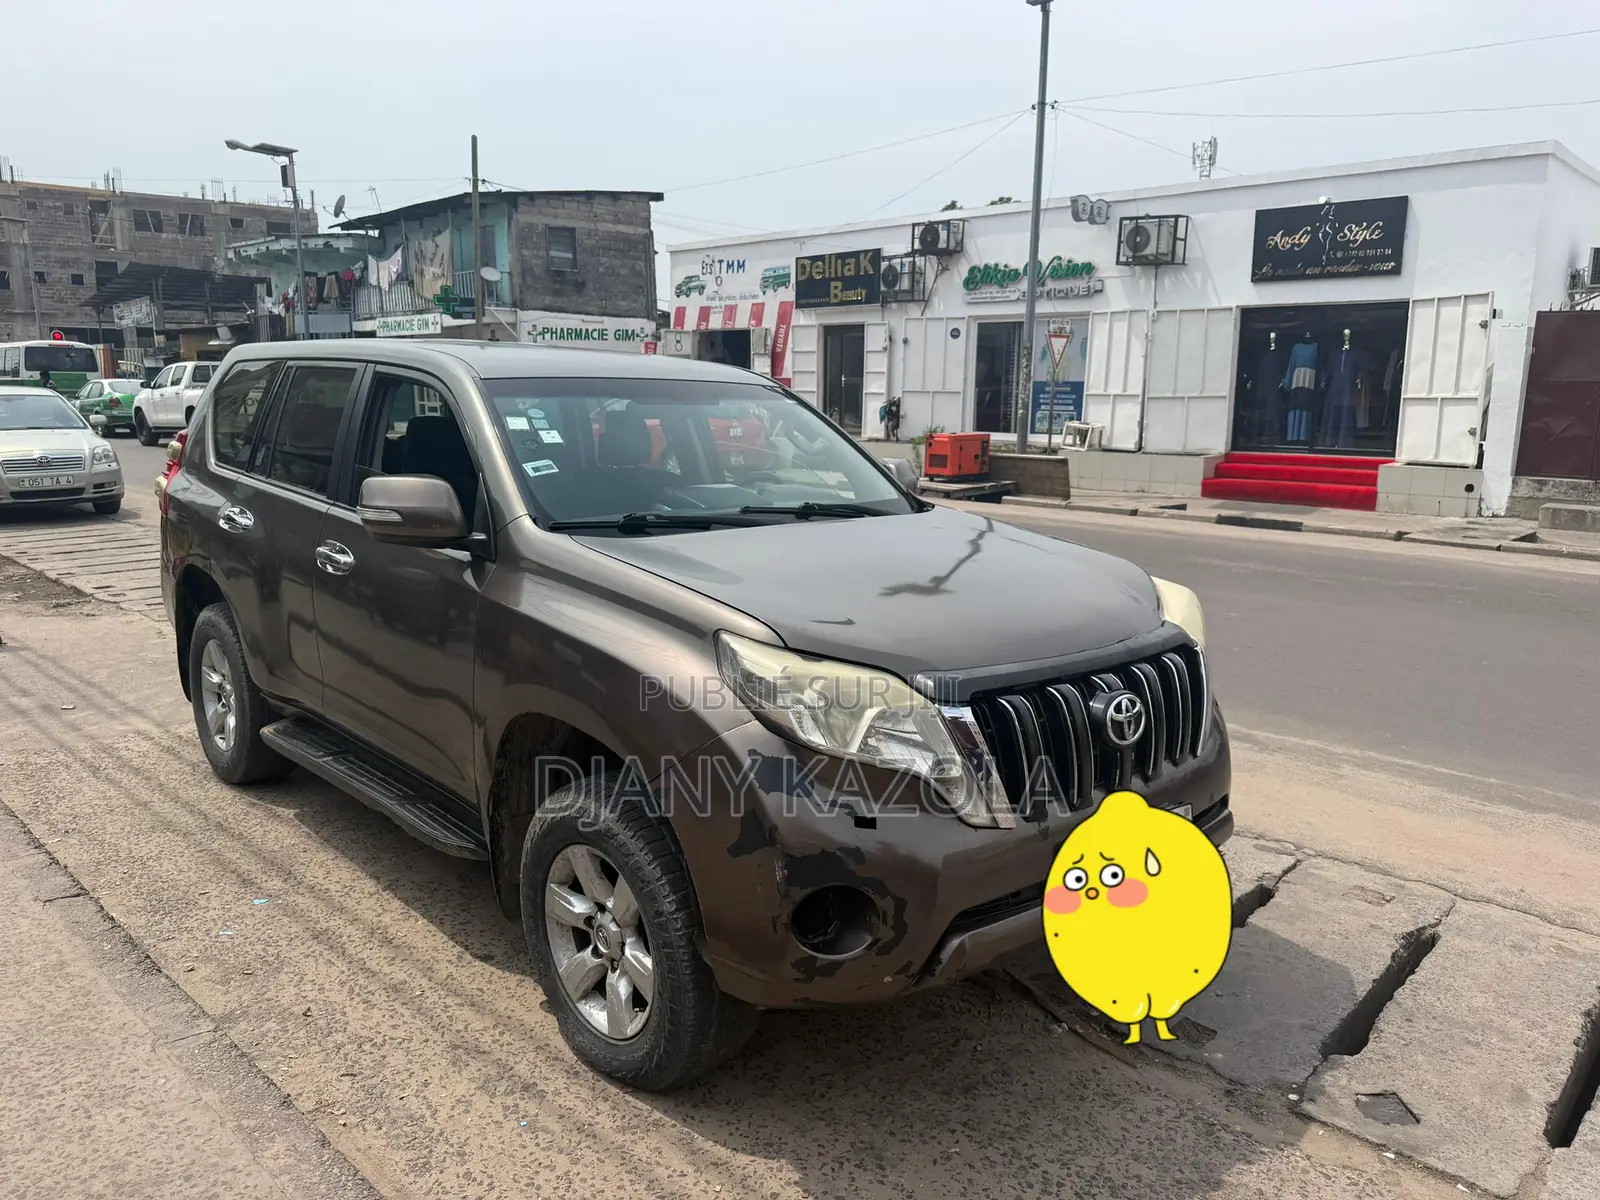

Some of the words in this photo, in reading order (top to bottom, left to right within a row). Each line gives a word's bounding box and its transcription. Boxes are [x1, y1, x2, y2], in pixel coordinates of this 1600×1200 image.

[1265, 226, 1312, 251] Andy
[1337, 221, 1384, 247] Style
[717, 259, 746, 275] TMM
[962, 262, 1021, 291] Elikia
[1022, 255, 1096, 287] Vision
[382, 318, 415, 333] PHARMACIE
[416, 317, 430, 332] GIM
[541, 326, 609, 341] PHARMACIE
[613, 328, 636, 342] GIM
[775, 324, 788, 353] TOYOTA
[28, 478, 44, 487] 051
[50, 476, 61, 485] TA
